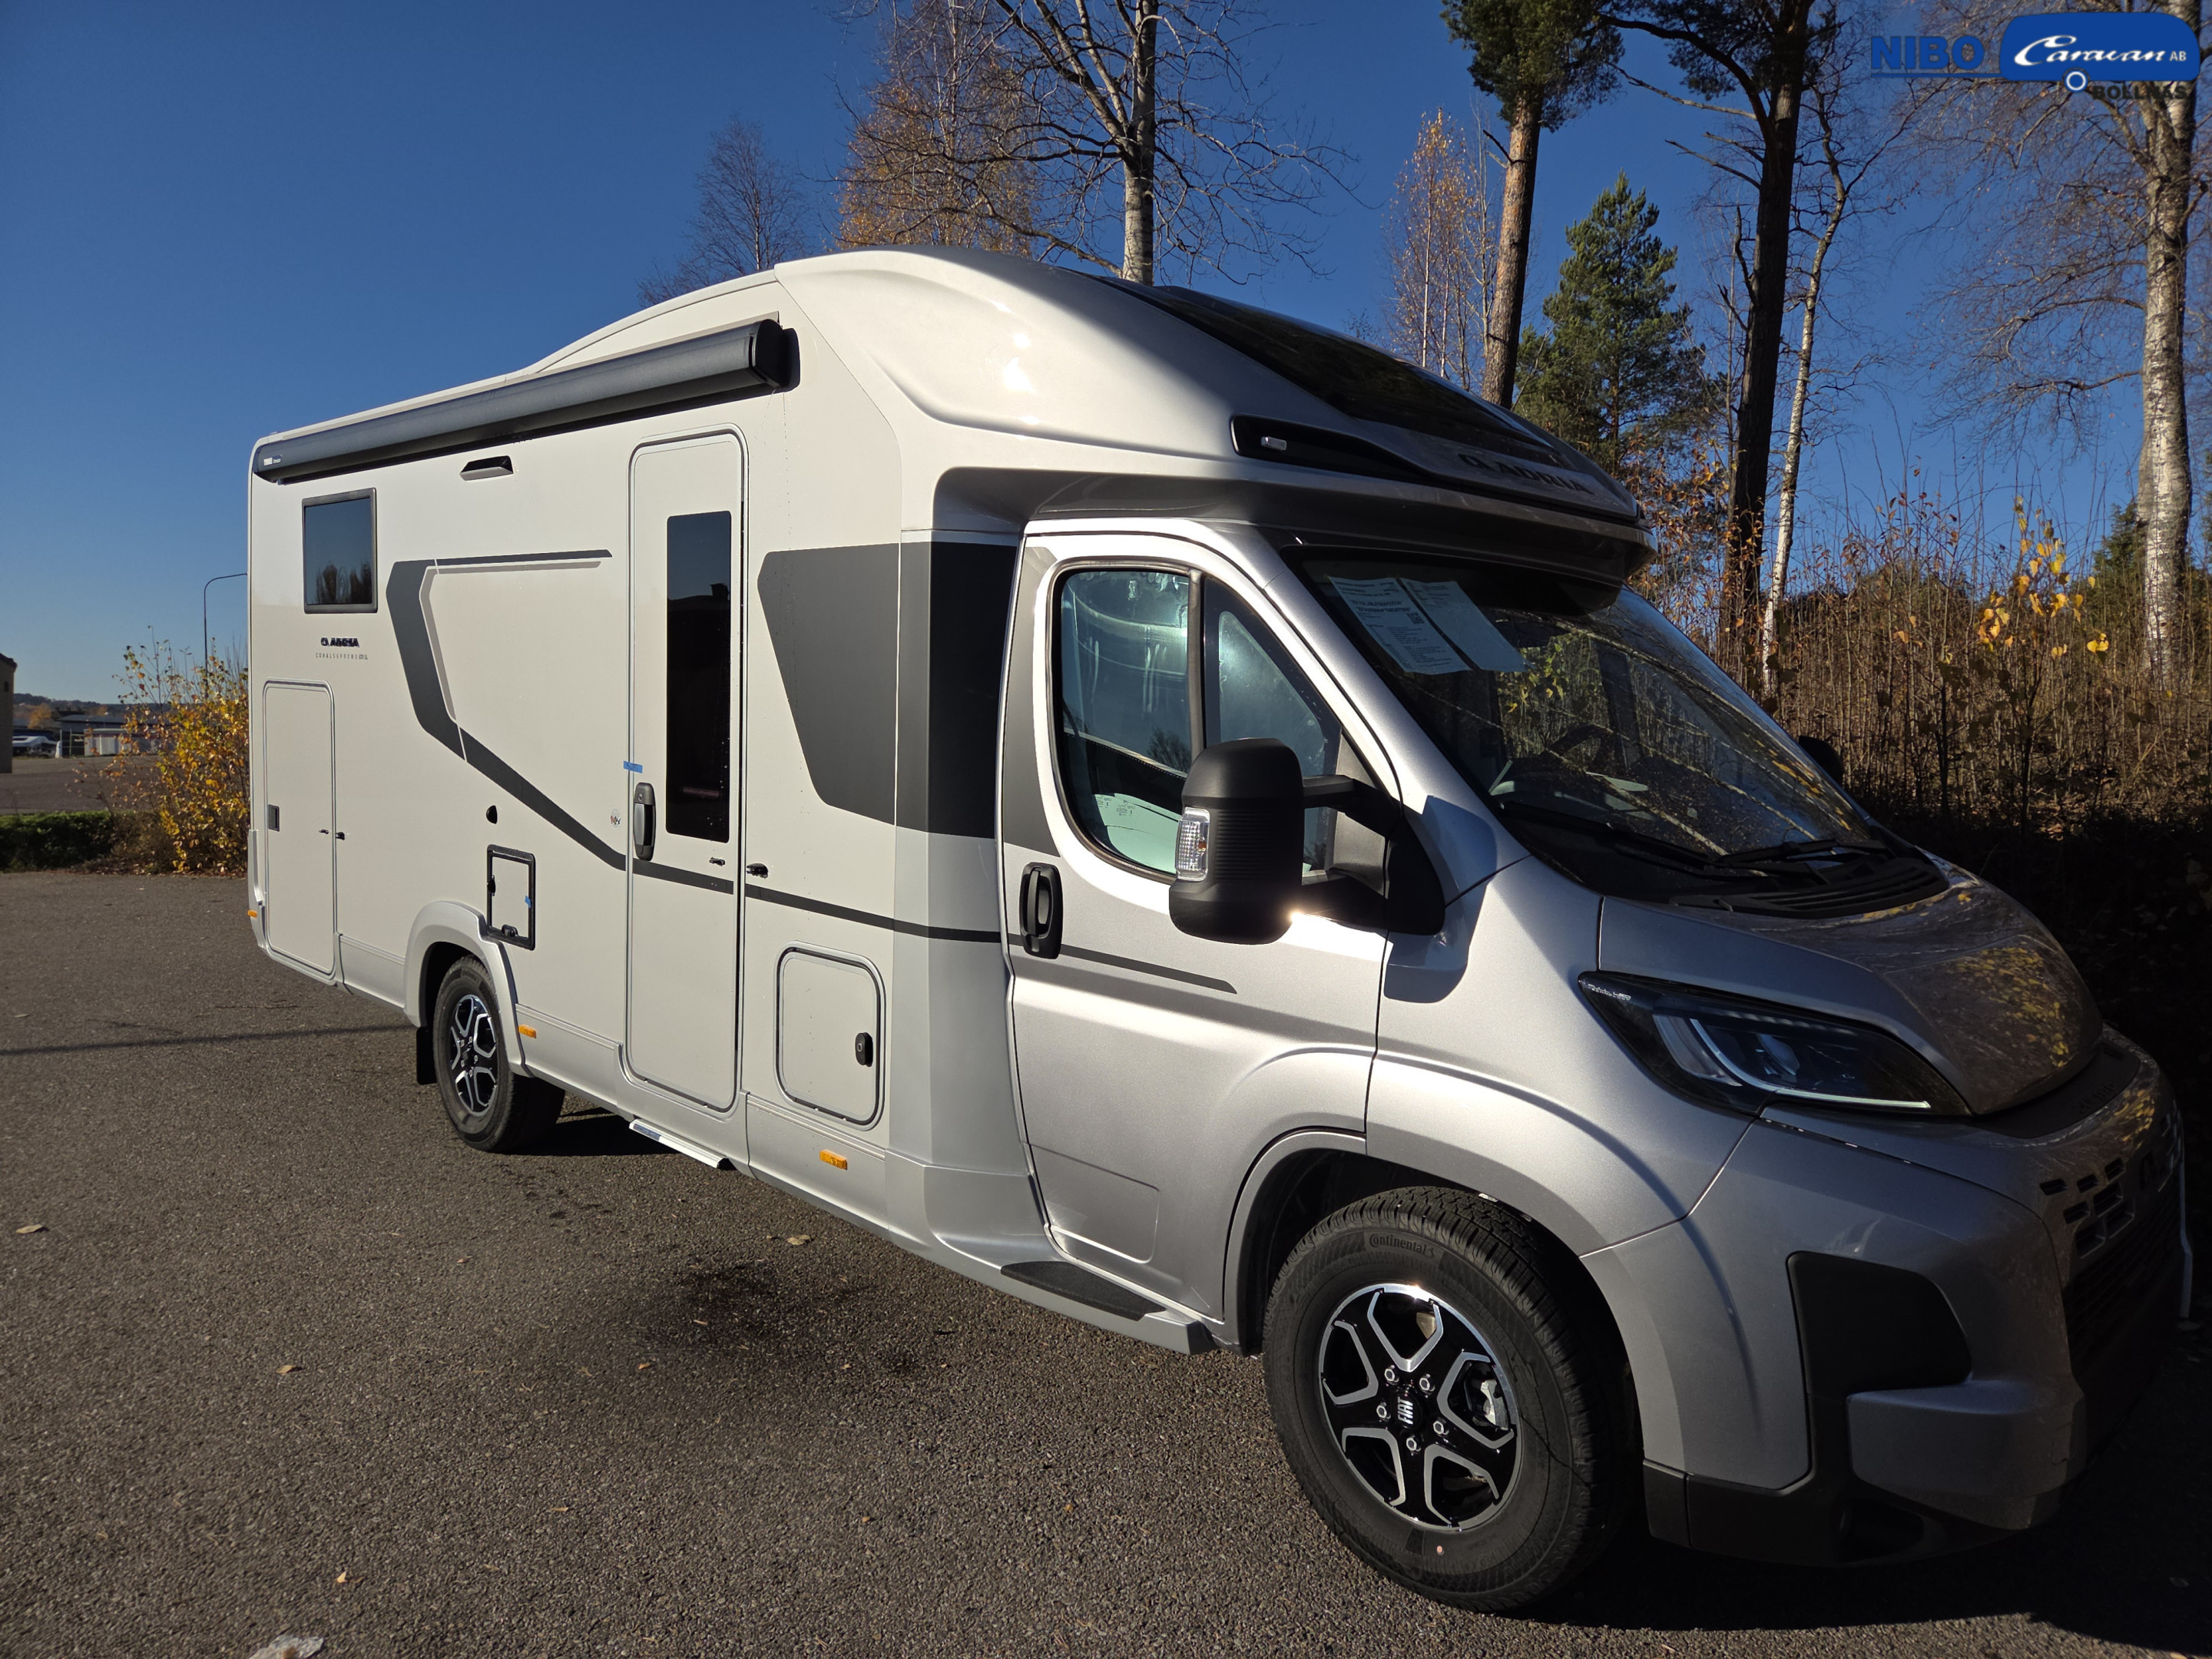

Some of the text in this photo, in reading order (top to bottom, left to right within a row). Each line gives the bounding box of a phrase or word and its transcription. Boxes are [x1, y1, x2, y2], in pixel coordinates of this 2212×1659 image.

[1495, 461, 1597, 496] ADRIA
[1369, 1233, 1428, 1256] Continental
[1397, 1396, 1414, 1426] FIAT
